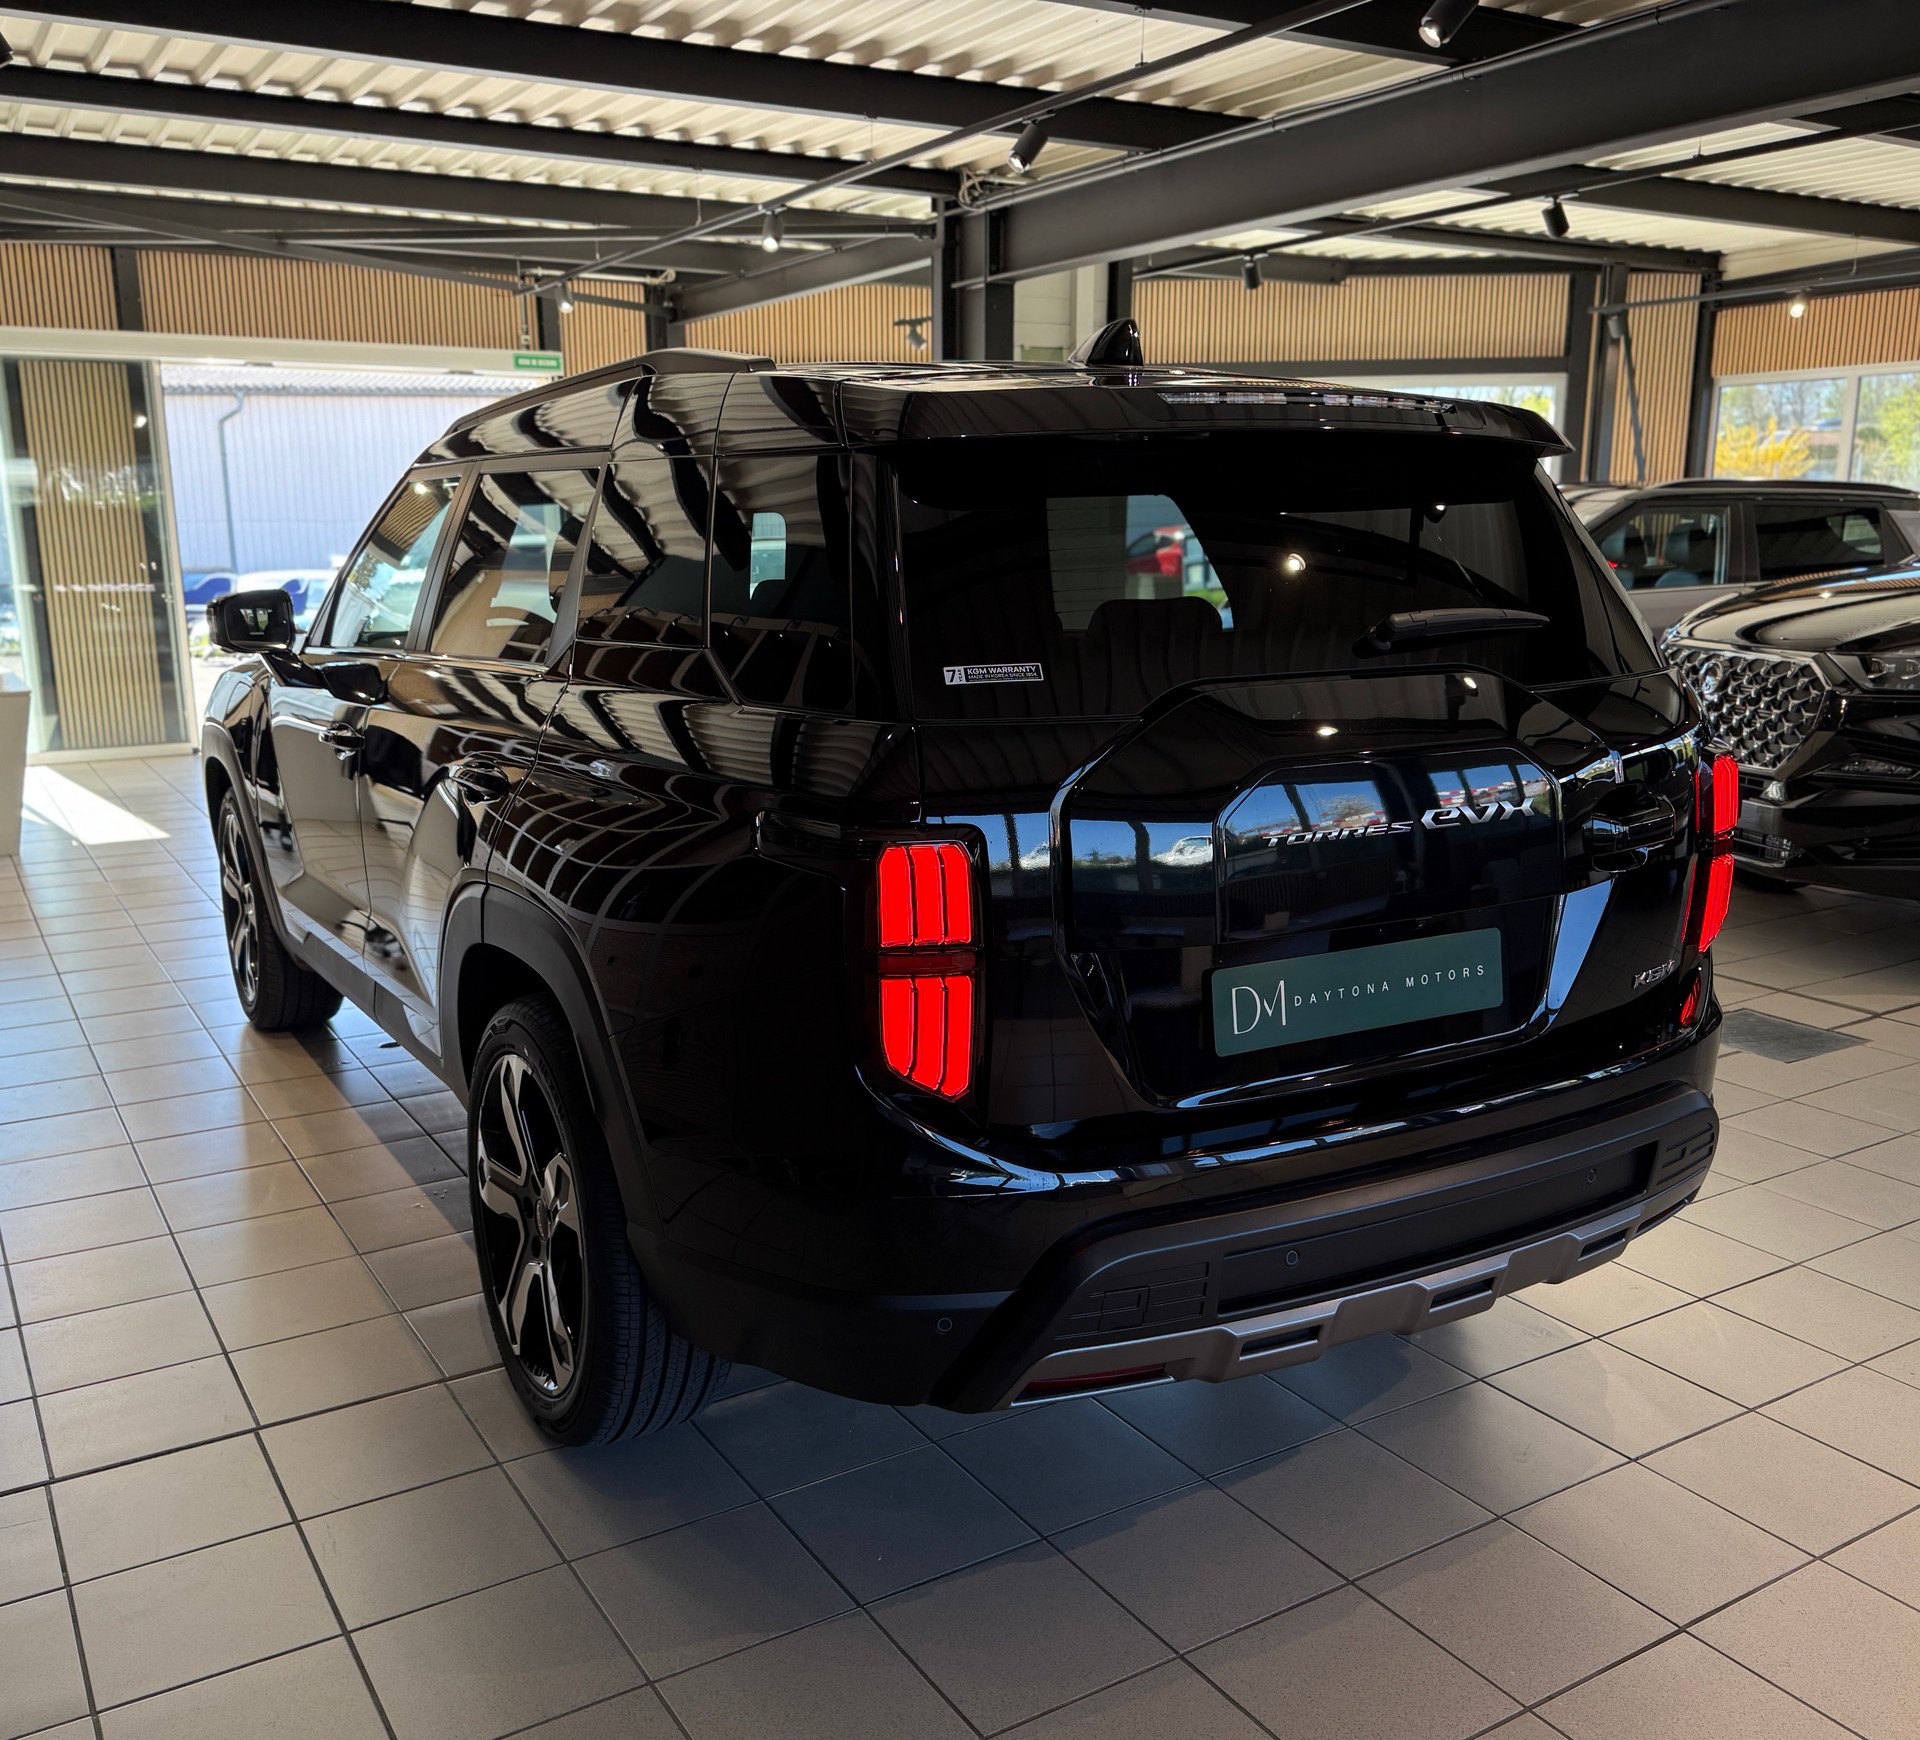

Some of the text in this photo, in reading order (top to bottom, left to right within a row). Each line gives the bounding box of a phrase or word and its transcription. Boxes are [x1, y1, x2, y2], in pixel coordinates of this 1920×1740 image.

[946, 669, 956, 683] 7
[967, 665, 1036, 675] KGM WARRANTY
[1262, 821, 1414, 847] TORRES
[1294, 965, 1484, 1007] DAYTONA MOTORS
[1633, 959, 1675, 989] KGM
